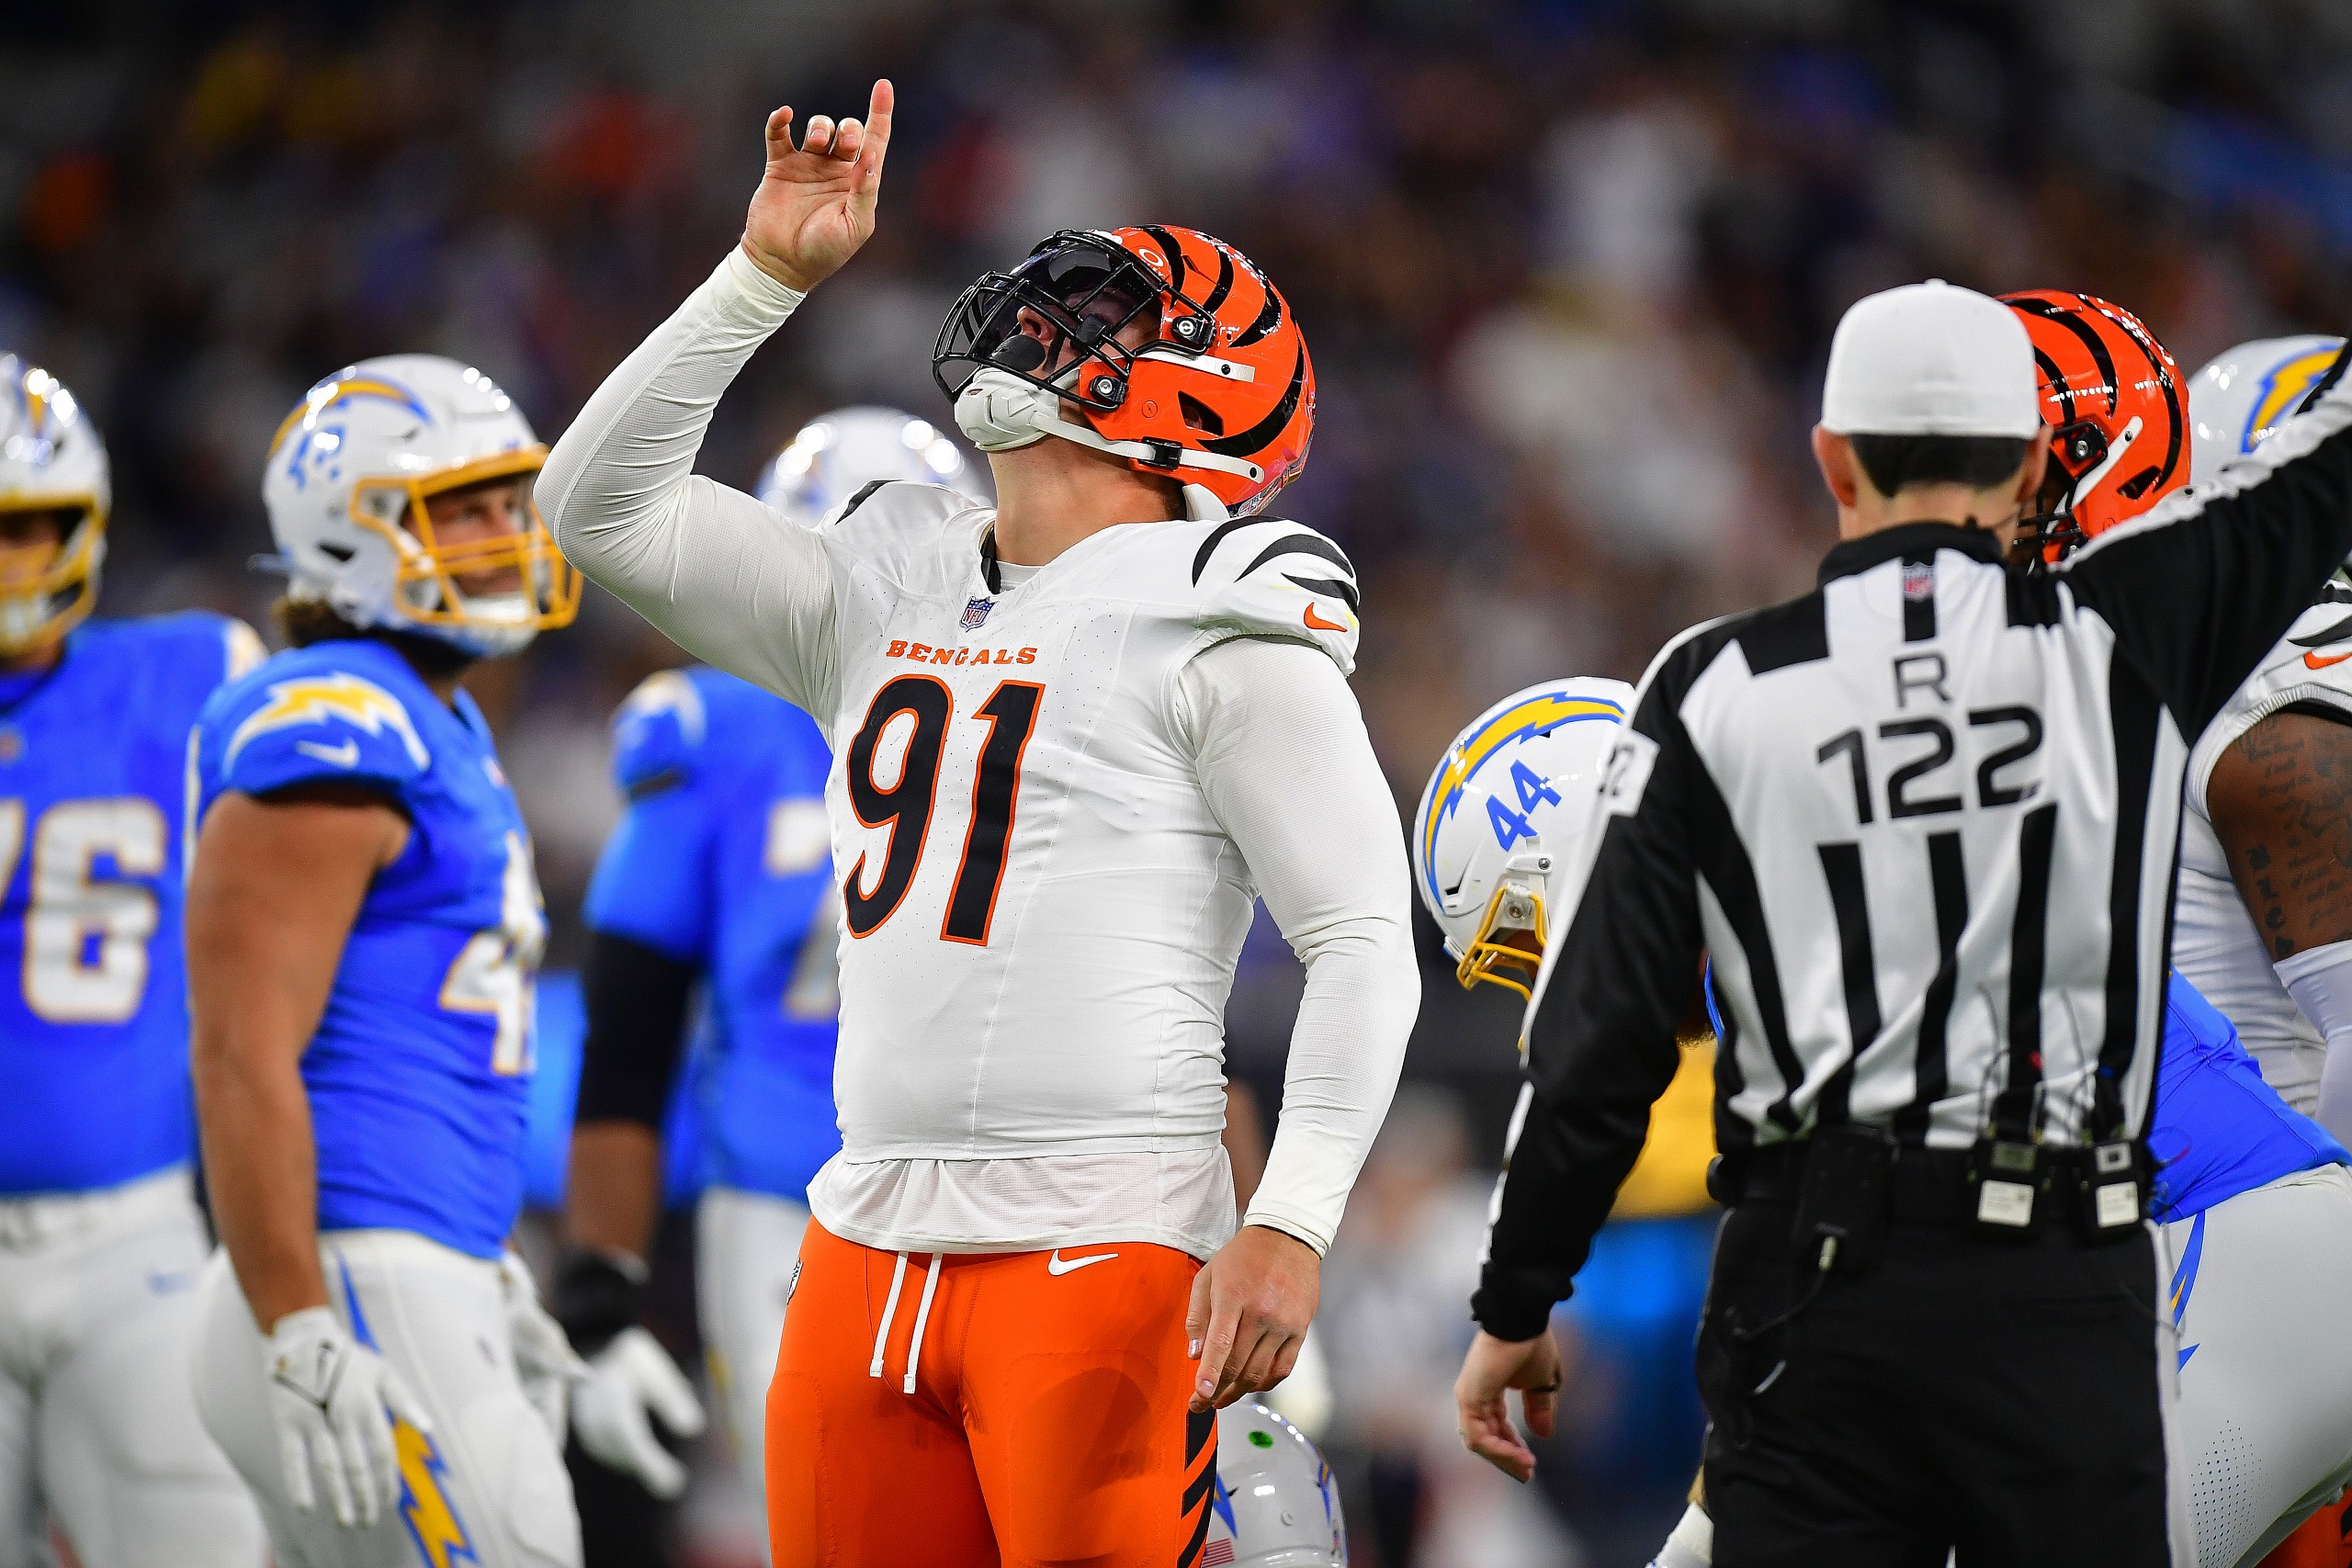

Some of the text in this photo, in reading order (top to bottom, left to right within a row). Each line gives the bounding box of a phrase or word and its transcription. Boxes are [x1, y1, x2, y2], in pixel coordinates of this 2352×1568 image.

[886, 639, 1037, 665] BENGALS
[1893, 650, 1951, 707] R
[843, 673, 1046, 948] 91
[1486, 759, 1563, 852] 44
[1816, 705, 2044, 825] 122
[0, 795, 171, 1026] 6
[438, 829, 544, 1077] 4
